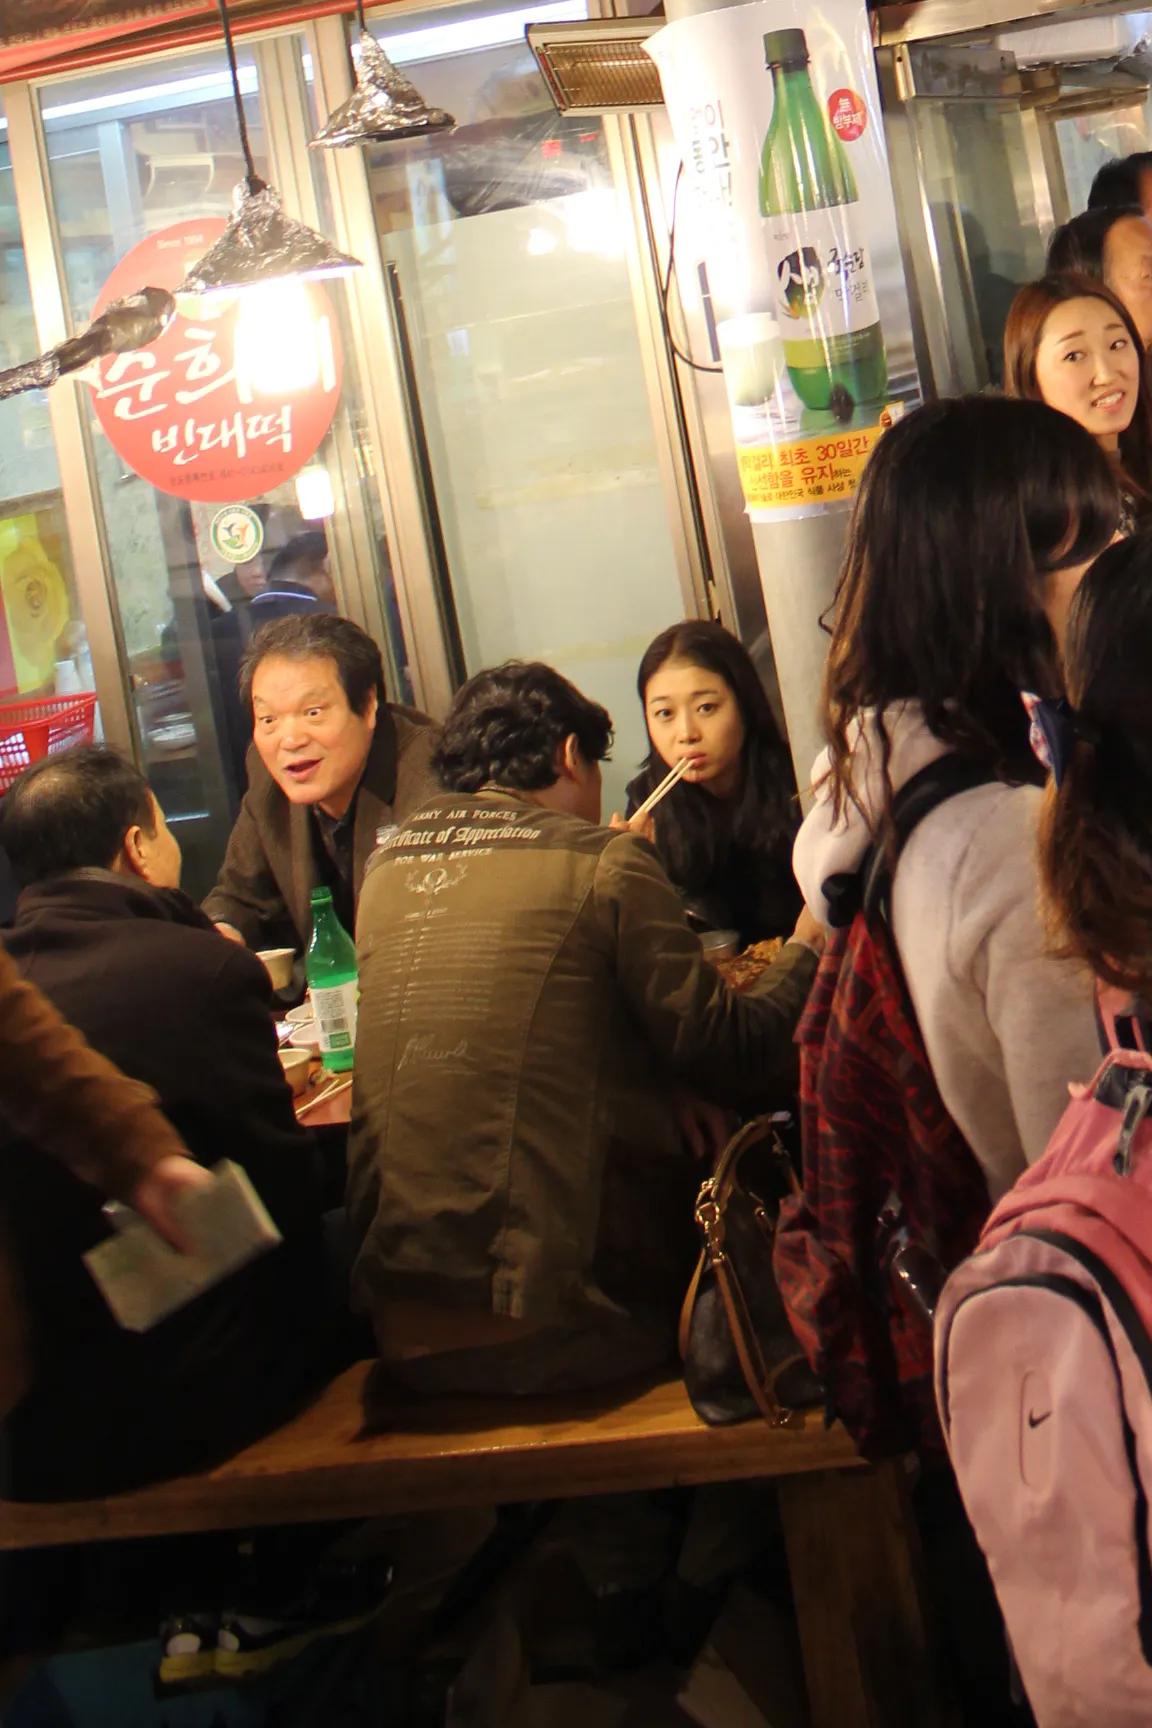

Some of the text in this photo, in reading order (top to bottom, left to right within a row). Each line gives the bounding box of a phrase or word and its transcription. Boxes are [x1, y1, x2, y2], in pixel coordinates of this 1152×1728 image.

[151, 404, 292, 466] 빈대떡
[779, 447, 811, 466] 최초
[816, 435, 870, 462] 30일간
[446, 809, 467, 821] AIR
[472, 809, 519, 821] FORCES
[435, 825, 457, 845] of
[451, 825, 543, 846] Appreciation
[394, 846, 494, 866] FOR WAR SERVICE
